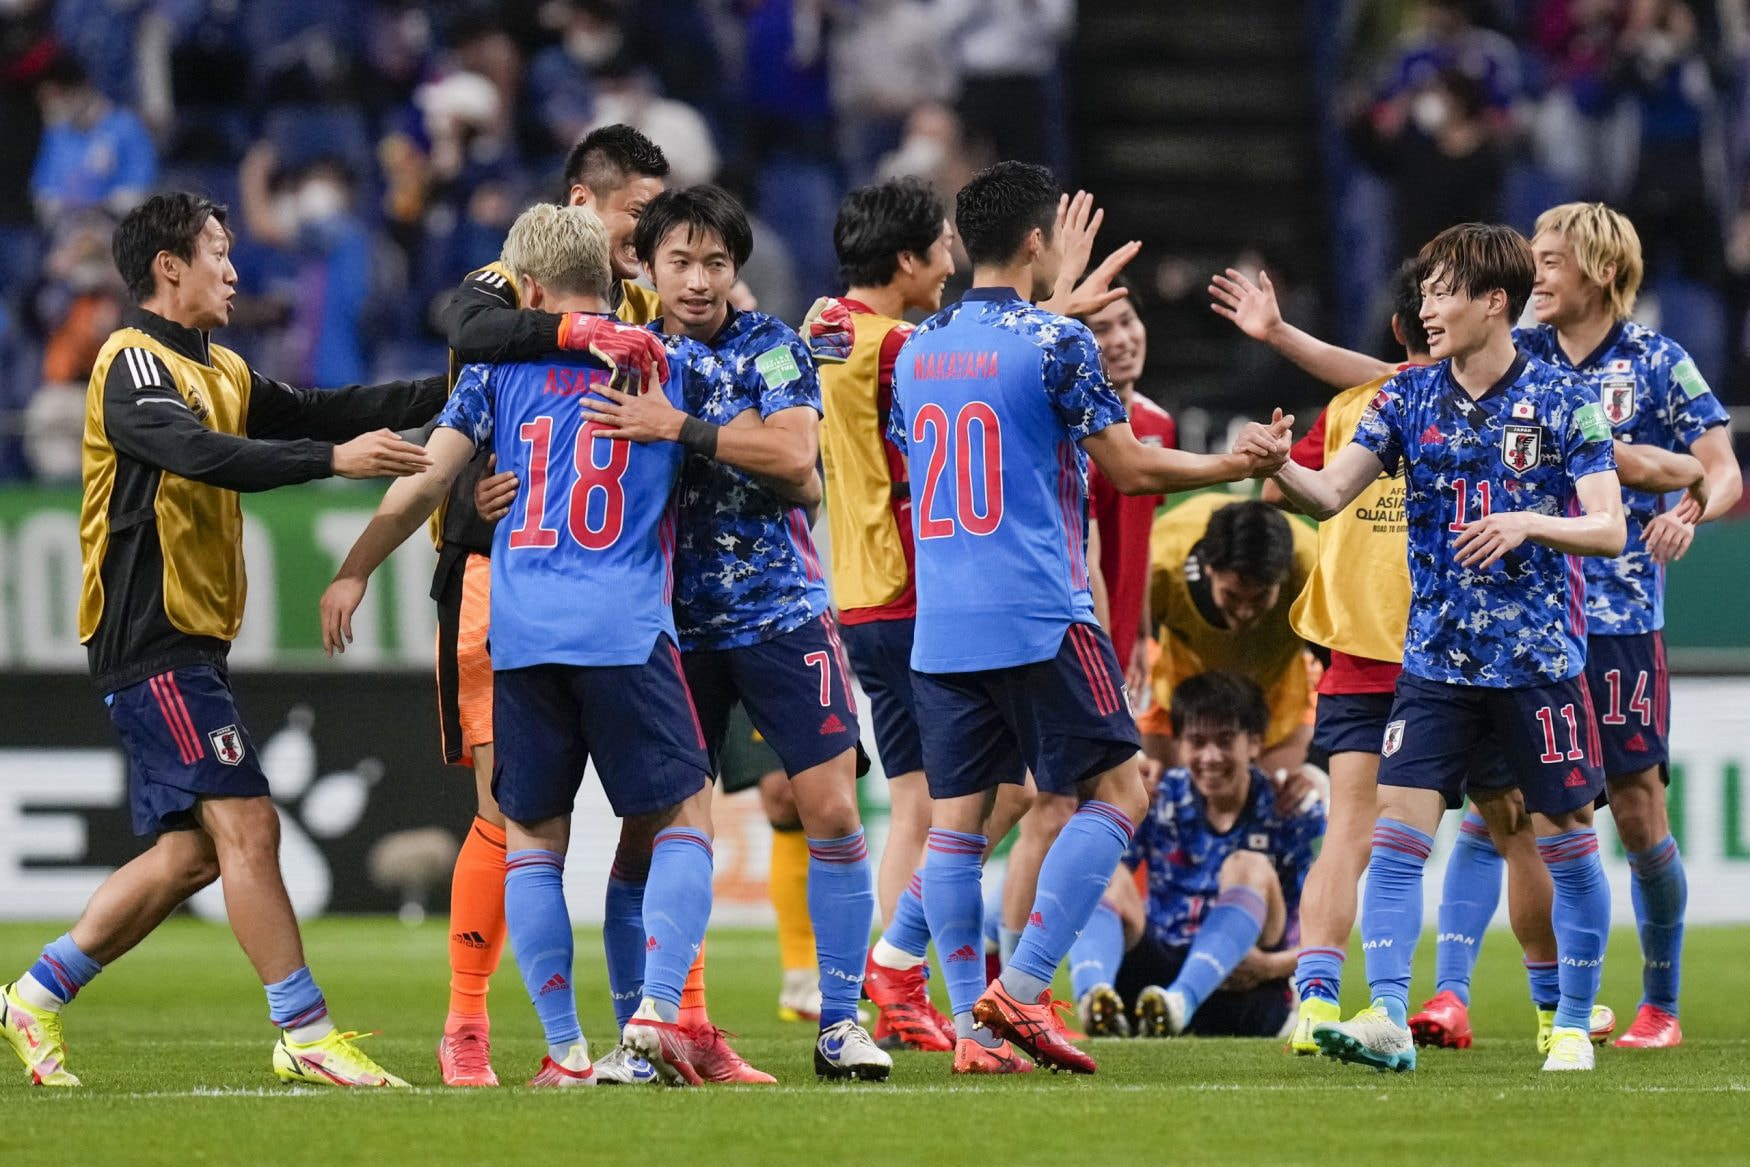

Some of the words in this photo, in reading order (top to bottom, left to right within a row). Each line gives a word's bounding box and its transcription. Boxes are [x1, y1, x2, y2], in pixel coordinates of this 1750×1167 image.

[914, 351, 999, 381] NAKAYAMA
[509, 415, 631, 551] 18
[912, 400, 1004, 540] 20
[1448, 478, 1493, 533] 11
[803, 650, 831, 707] 7
[1602, 669, 1651, 726] 14
[1535, 703, 1584, 764] 11
